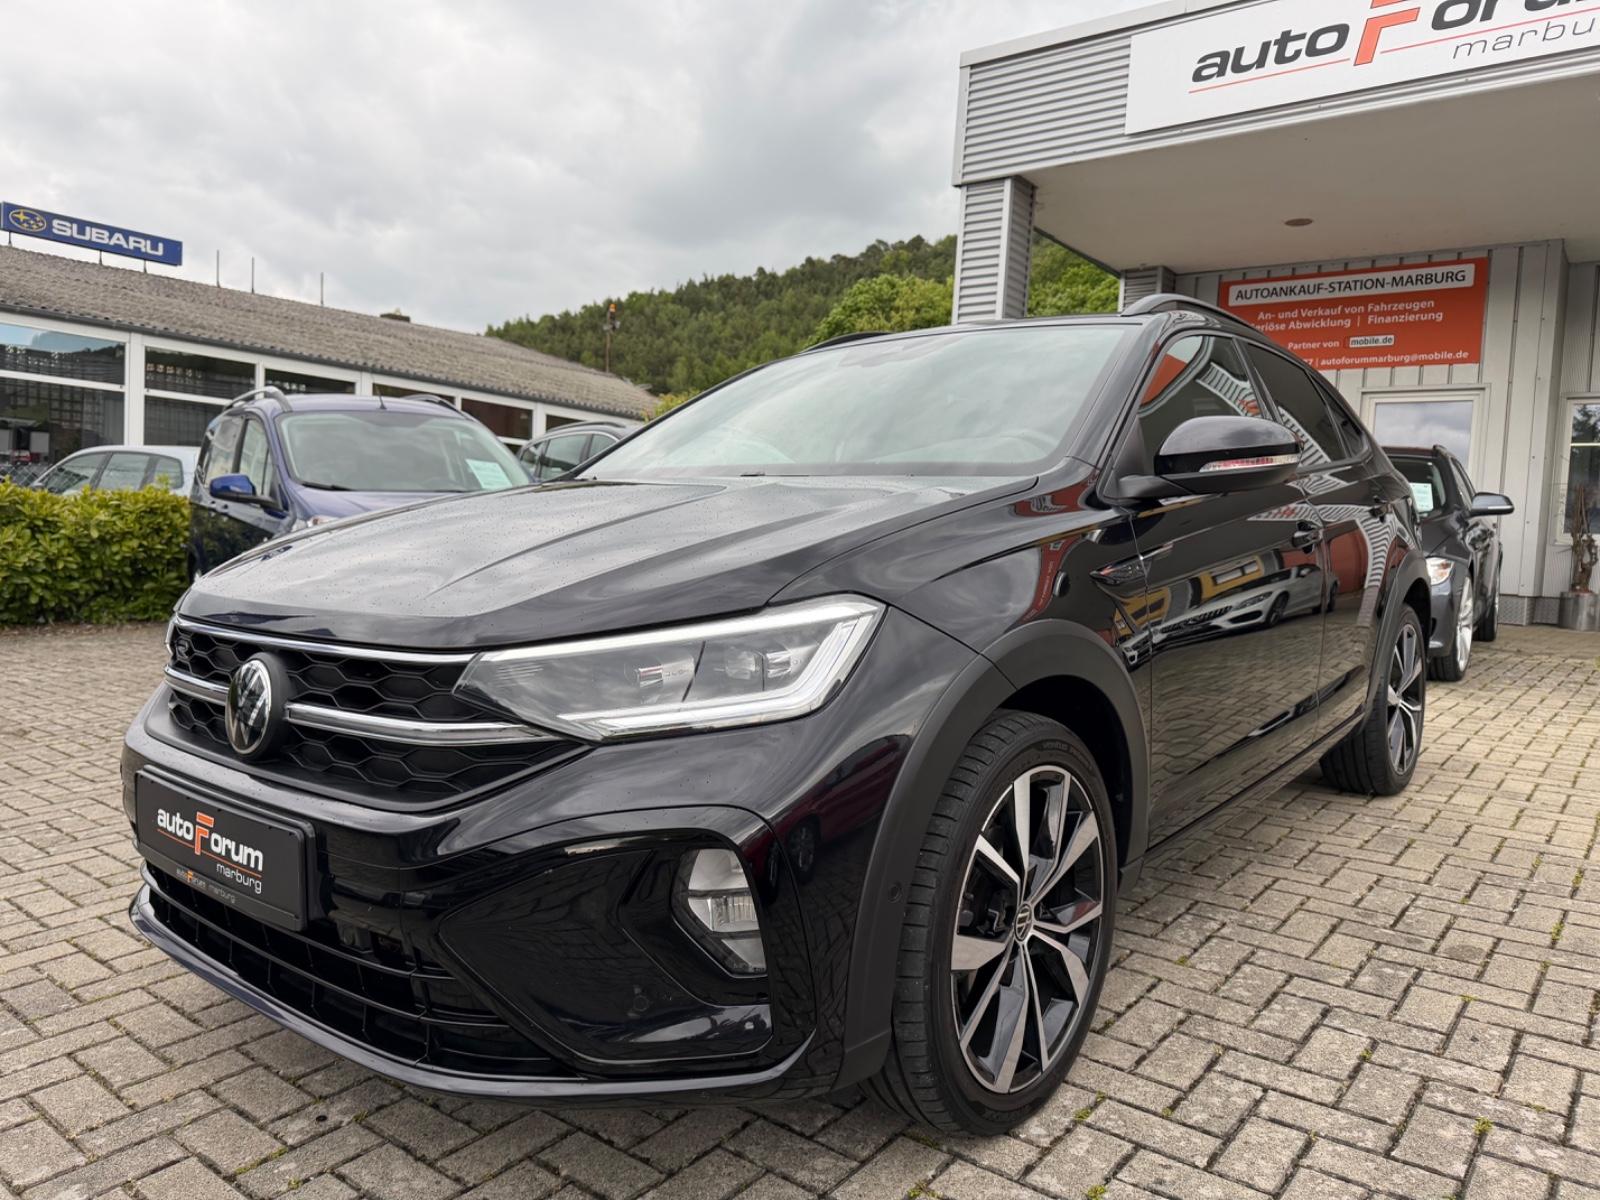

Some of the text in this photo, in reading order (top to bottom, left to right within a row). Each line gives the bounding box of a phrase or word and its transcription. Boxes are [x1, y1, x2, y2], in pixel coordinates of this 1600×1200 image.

[52, 218, 163, 256] SUBARU
[1235, 269, 1466, 301] AUTOANKAUF-STATION-MARBURG
[1257, 300, 1435, 320] An- und Verkauf von Fahrzeugen
[1288, 317, 1351, 330] Abwicklung
[1367, 311, 1444, 325] Finanzierung
[1287, 341, 1321, 350] Partner
[1350, 336, 1393, 346] mobile.de
[1320, 350, 1469, 366] autoforummarburg@mobile.de
[157, 808, 264, 871] autoForum
[216, 863, 262, 894] marburg
